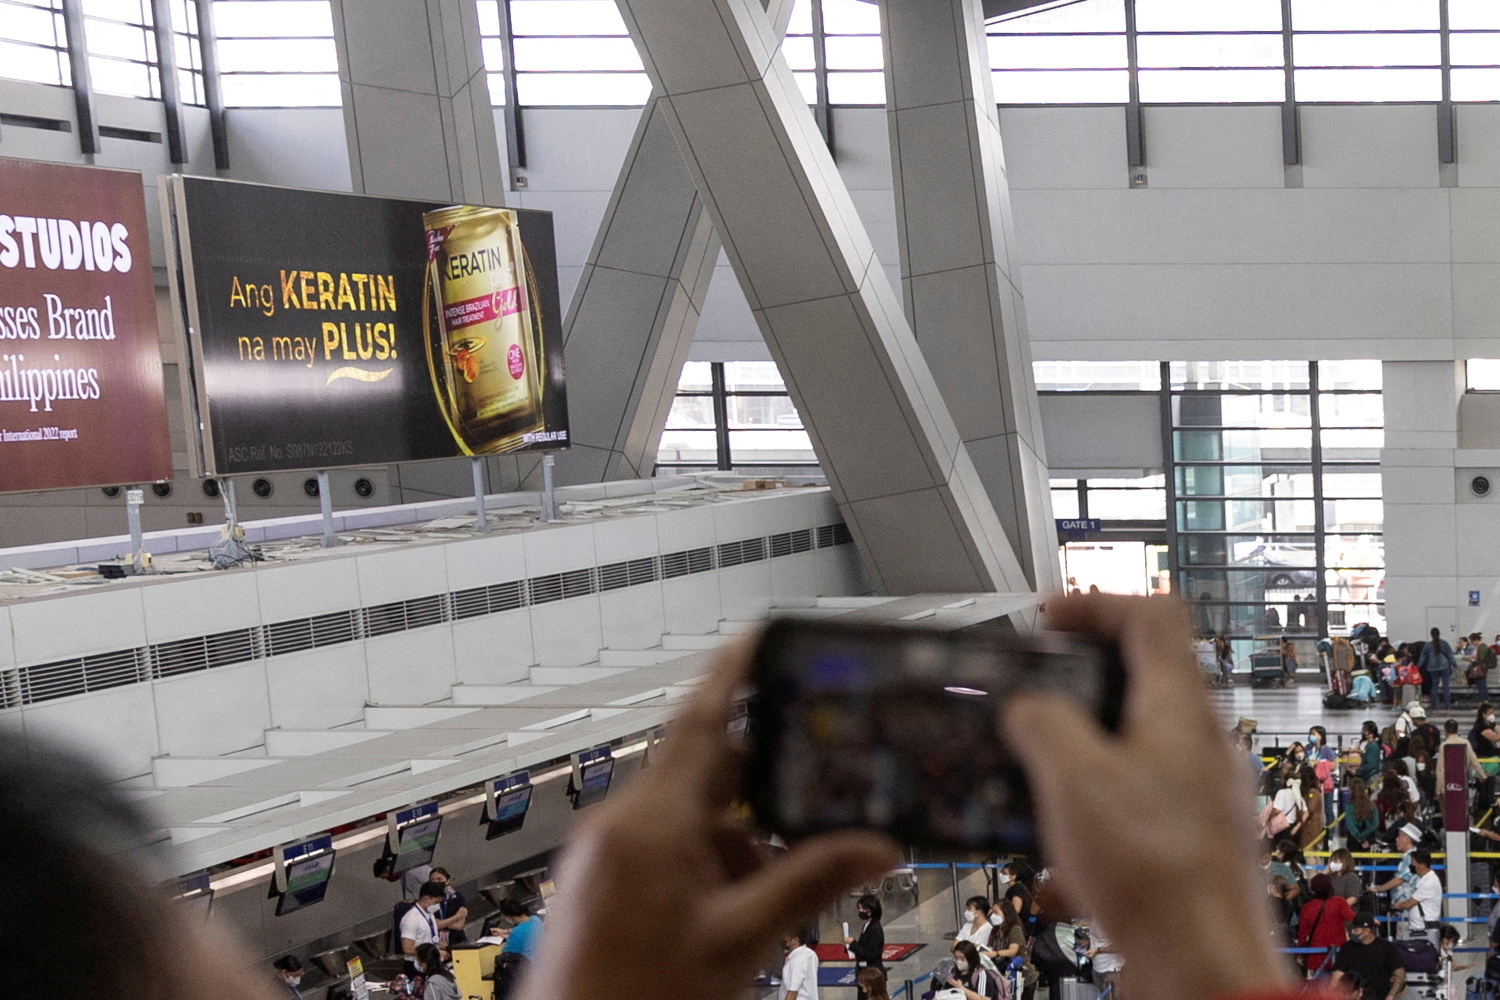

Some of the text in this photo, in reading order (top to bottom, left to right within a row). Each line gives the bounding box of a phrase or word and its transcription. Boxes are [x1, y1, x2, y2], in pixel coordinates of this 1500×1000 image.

[0, 215, 132, 273] STUDIOS
[230, 269, 398, 317] Ang KERATIN
[43, 293, 116, 341] Brand
[445, 304, 465, 319] INTENSE
[238, 321, 398, 368] na may PLUS!
[3, 428, 42, 442] International
[42, 426, 60, 440] 2022
[59, 427, 78, 442] report
[535, 431, 557, 442] REGULAR
[557, 430, 568, 440] USE
[1061, 520, 1095, 529] GATE 1
